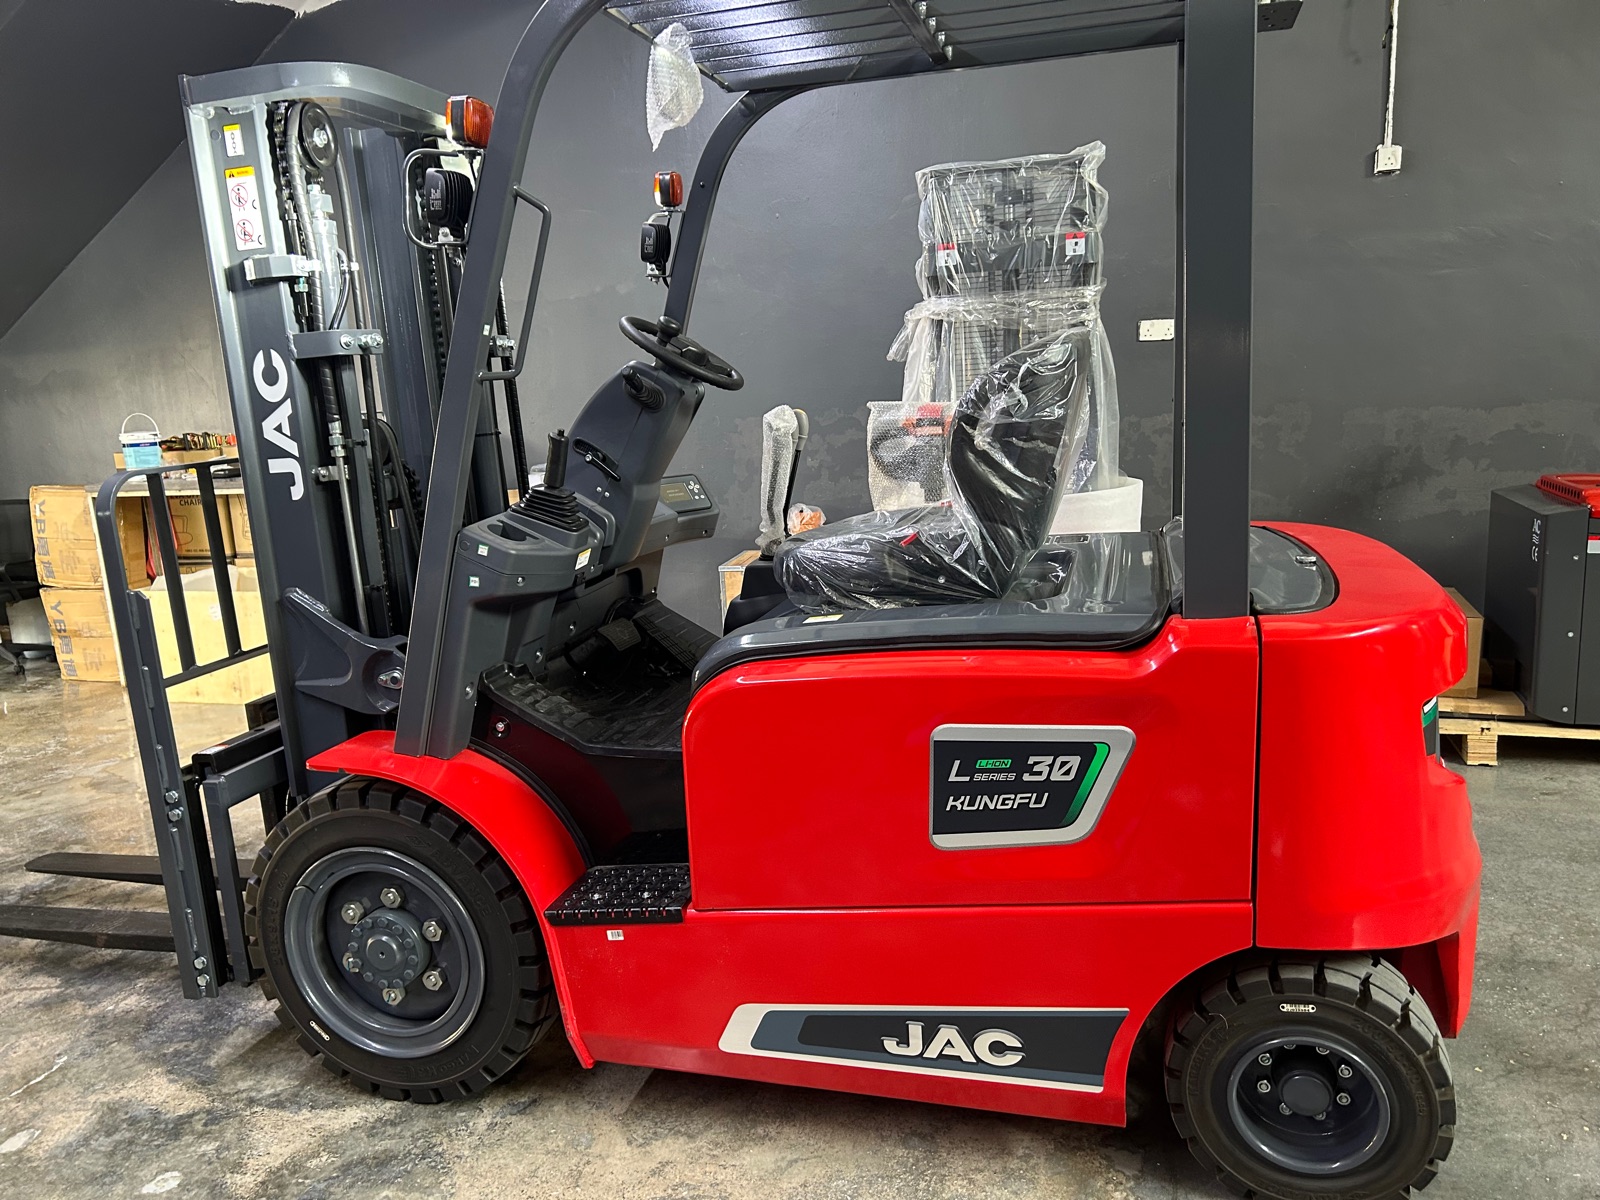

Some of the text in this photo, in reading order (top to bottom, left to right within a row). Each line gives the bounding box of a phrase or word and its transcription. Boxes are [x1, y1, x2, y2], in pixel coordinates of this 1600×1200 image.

[253, 349, 304, 500] JAC
[948, 756, 1081, 782] L SERIES 30
[978, 760, 1010, 768] LI-ION
[945, 793, 1048, 811] KUNGFU
[881, 1021, 1026, 1067] JAC
